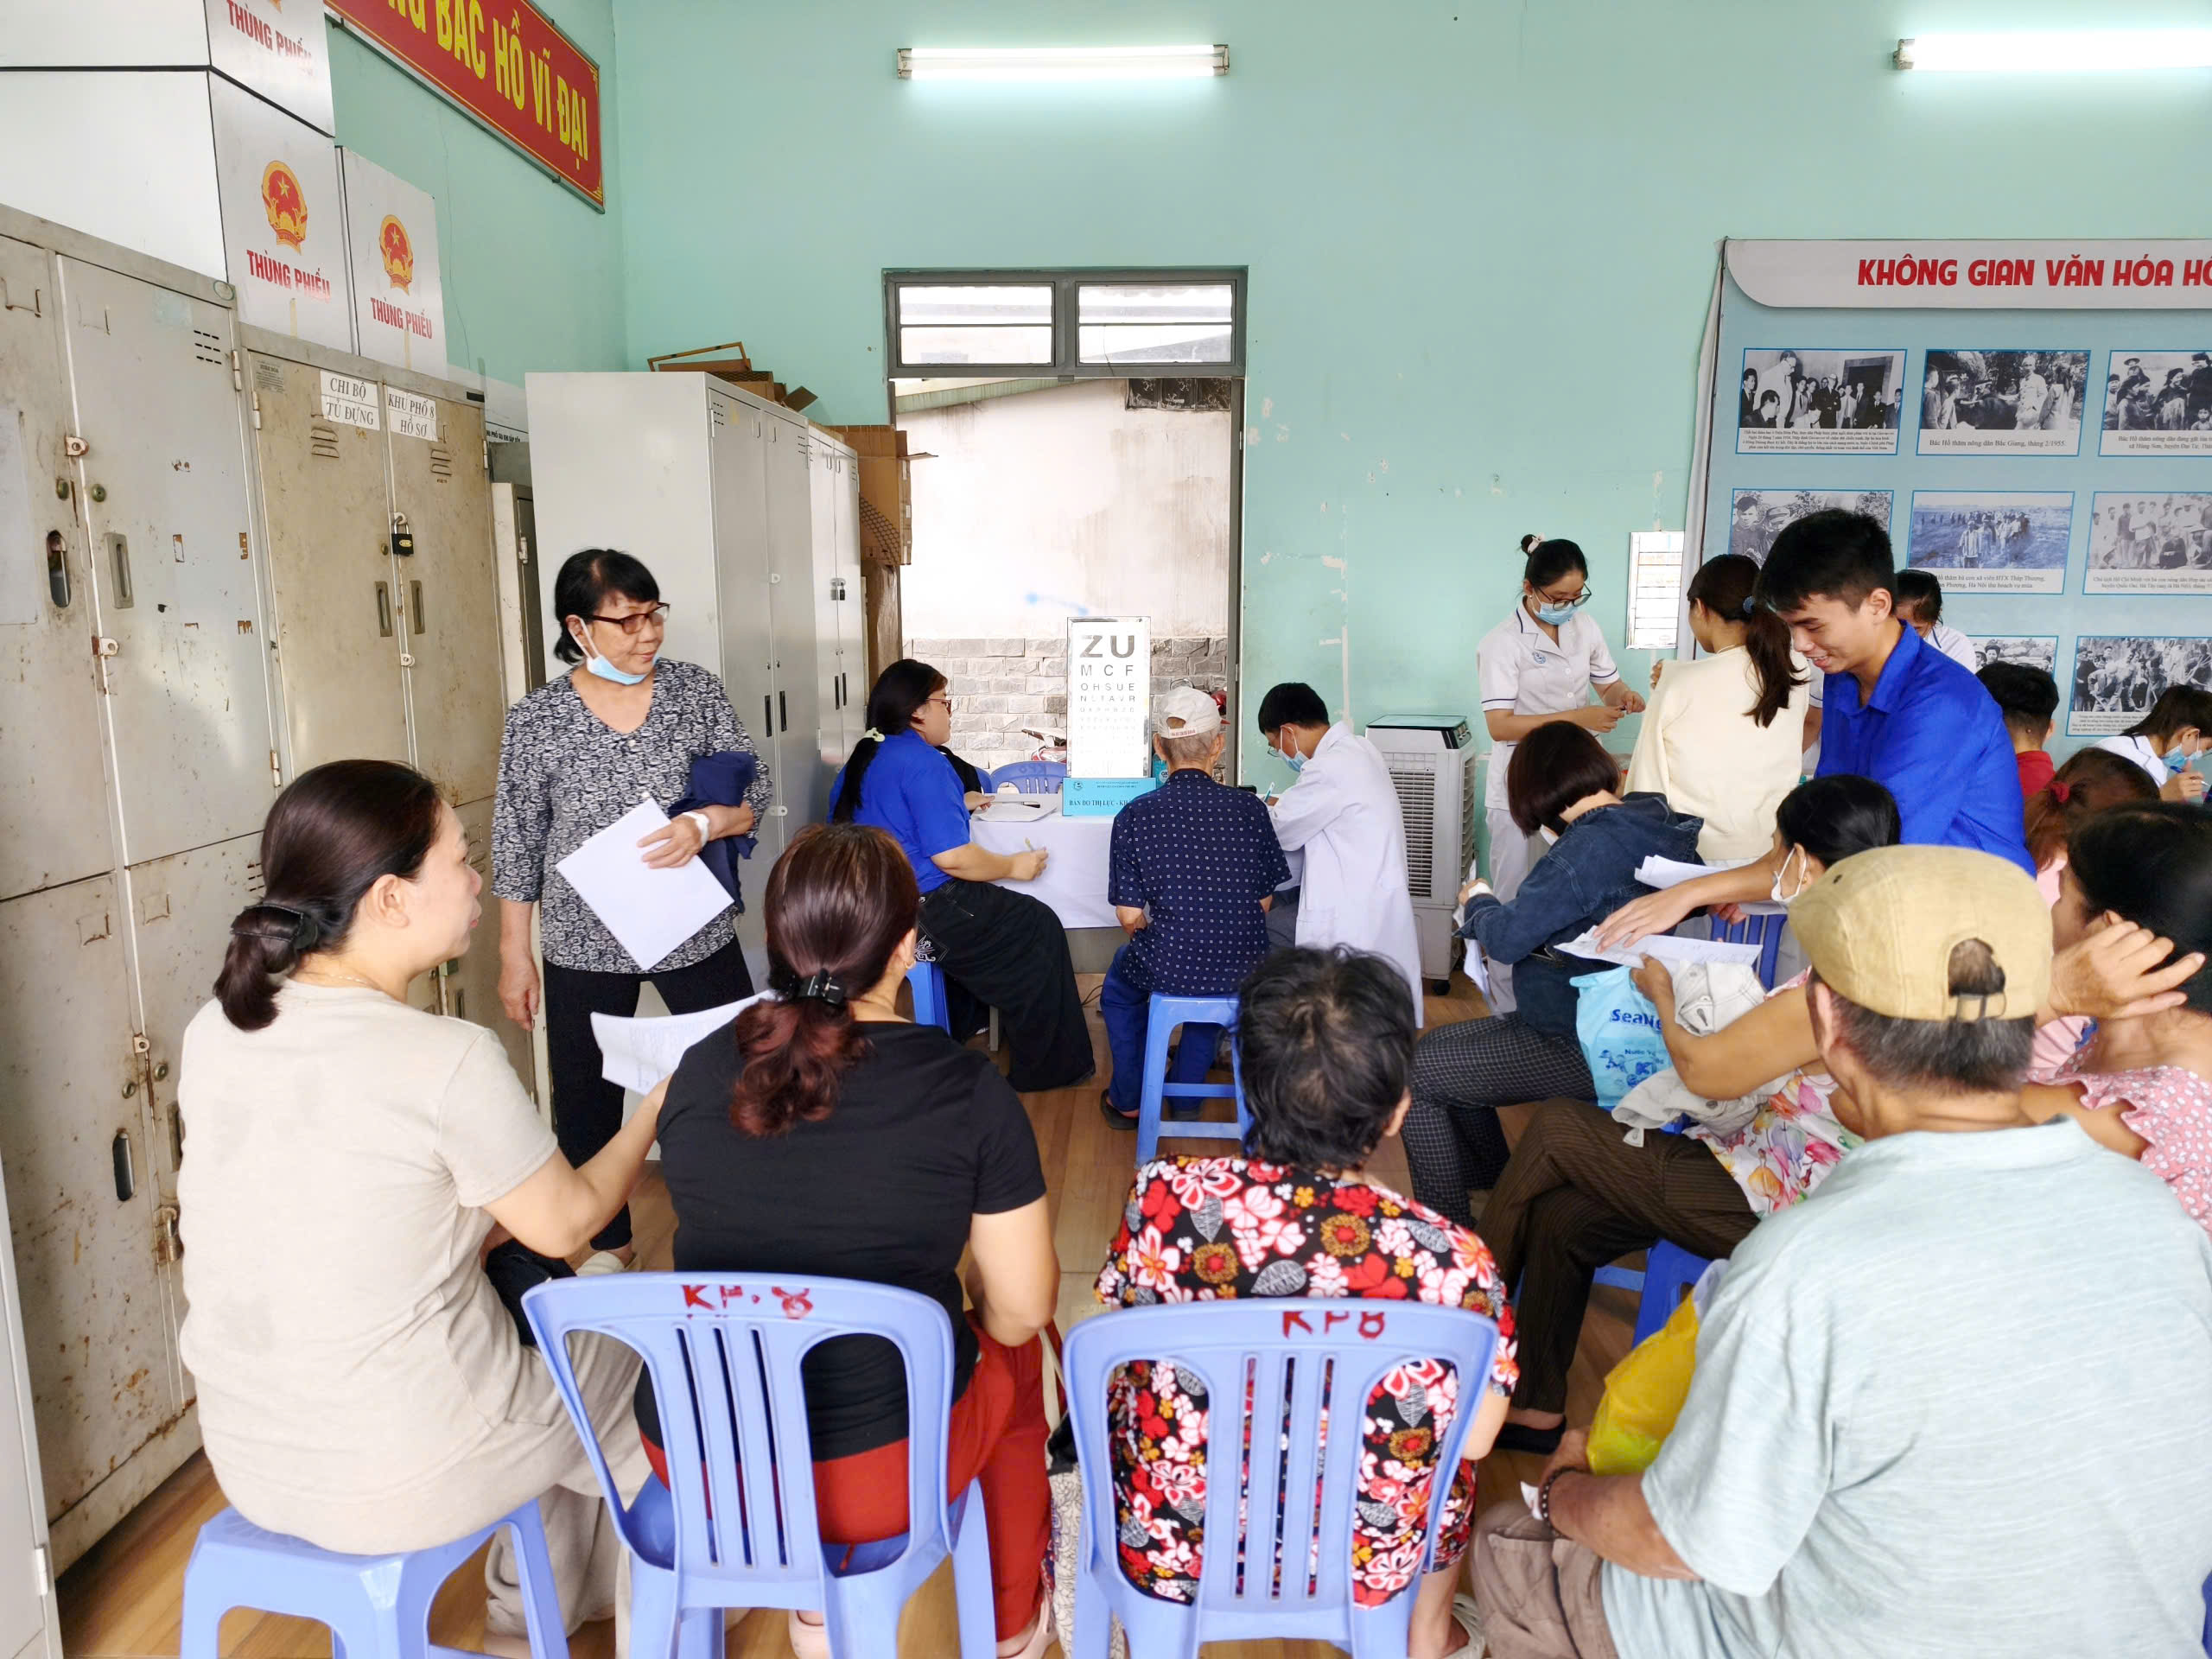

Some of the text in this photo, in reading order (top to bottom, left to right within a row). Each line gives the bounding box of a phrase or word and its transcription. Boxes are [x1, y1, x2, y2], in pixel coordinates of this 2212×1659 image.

[226, 0, 273, 51] THÙNG
[493, 8, 525, 111] HỒ
[530, 48, 552, 133] VĨ
[556, 75, 588, 171] ĐẠI
[246, 249, 291, 290] THÙNG
[1858, 253, 1958, 286] KHÔNG
[1967, 259, 2035, 286] GIAN
[2046, 254, 2105, 286] VĂN
[2113, 253, 2174, 287] HÓA
[370, 296, 433, 340] THÙNG PHIẾU
[330, 378, 366, 401] CHI BỘ
[388, 393, 435, 419] KHU PHỐ 8
[326, 397, 374, 425] TỦ ĐỰNG
[400, 416, 428, 437] HỒ SƠ
